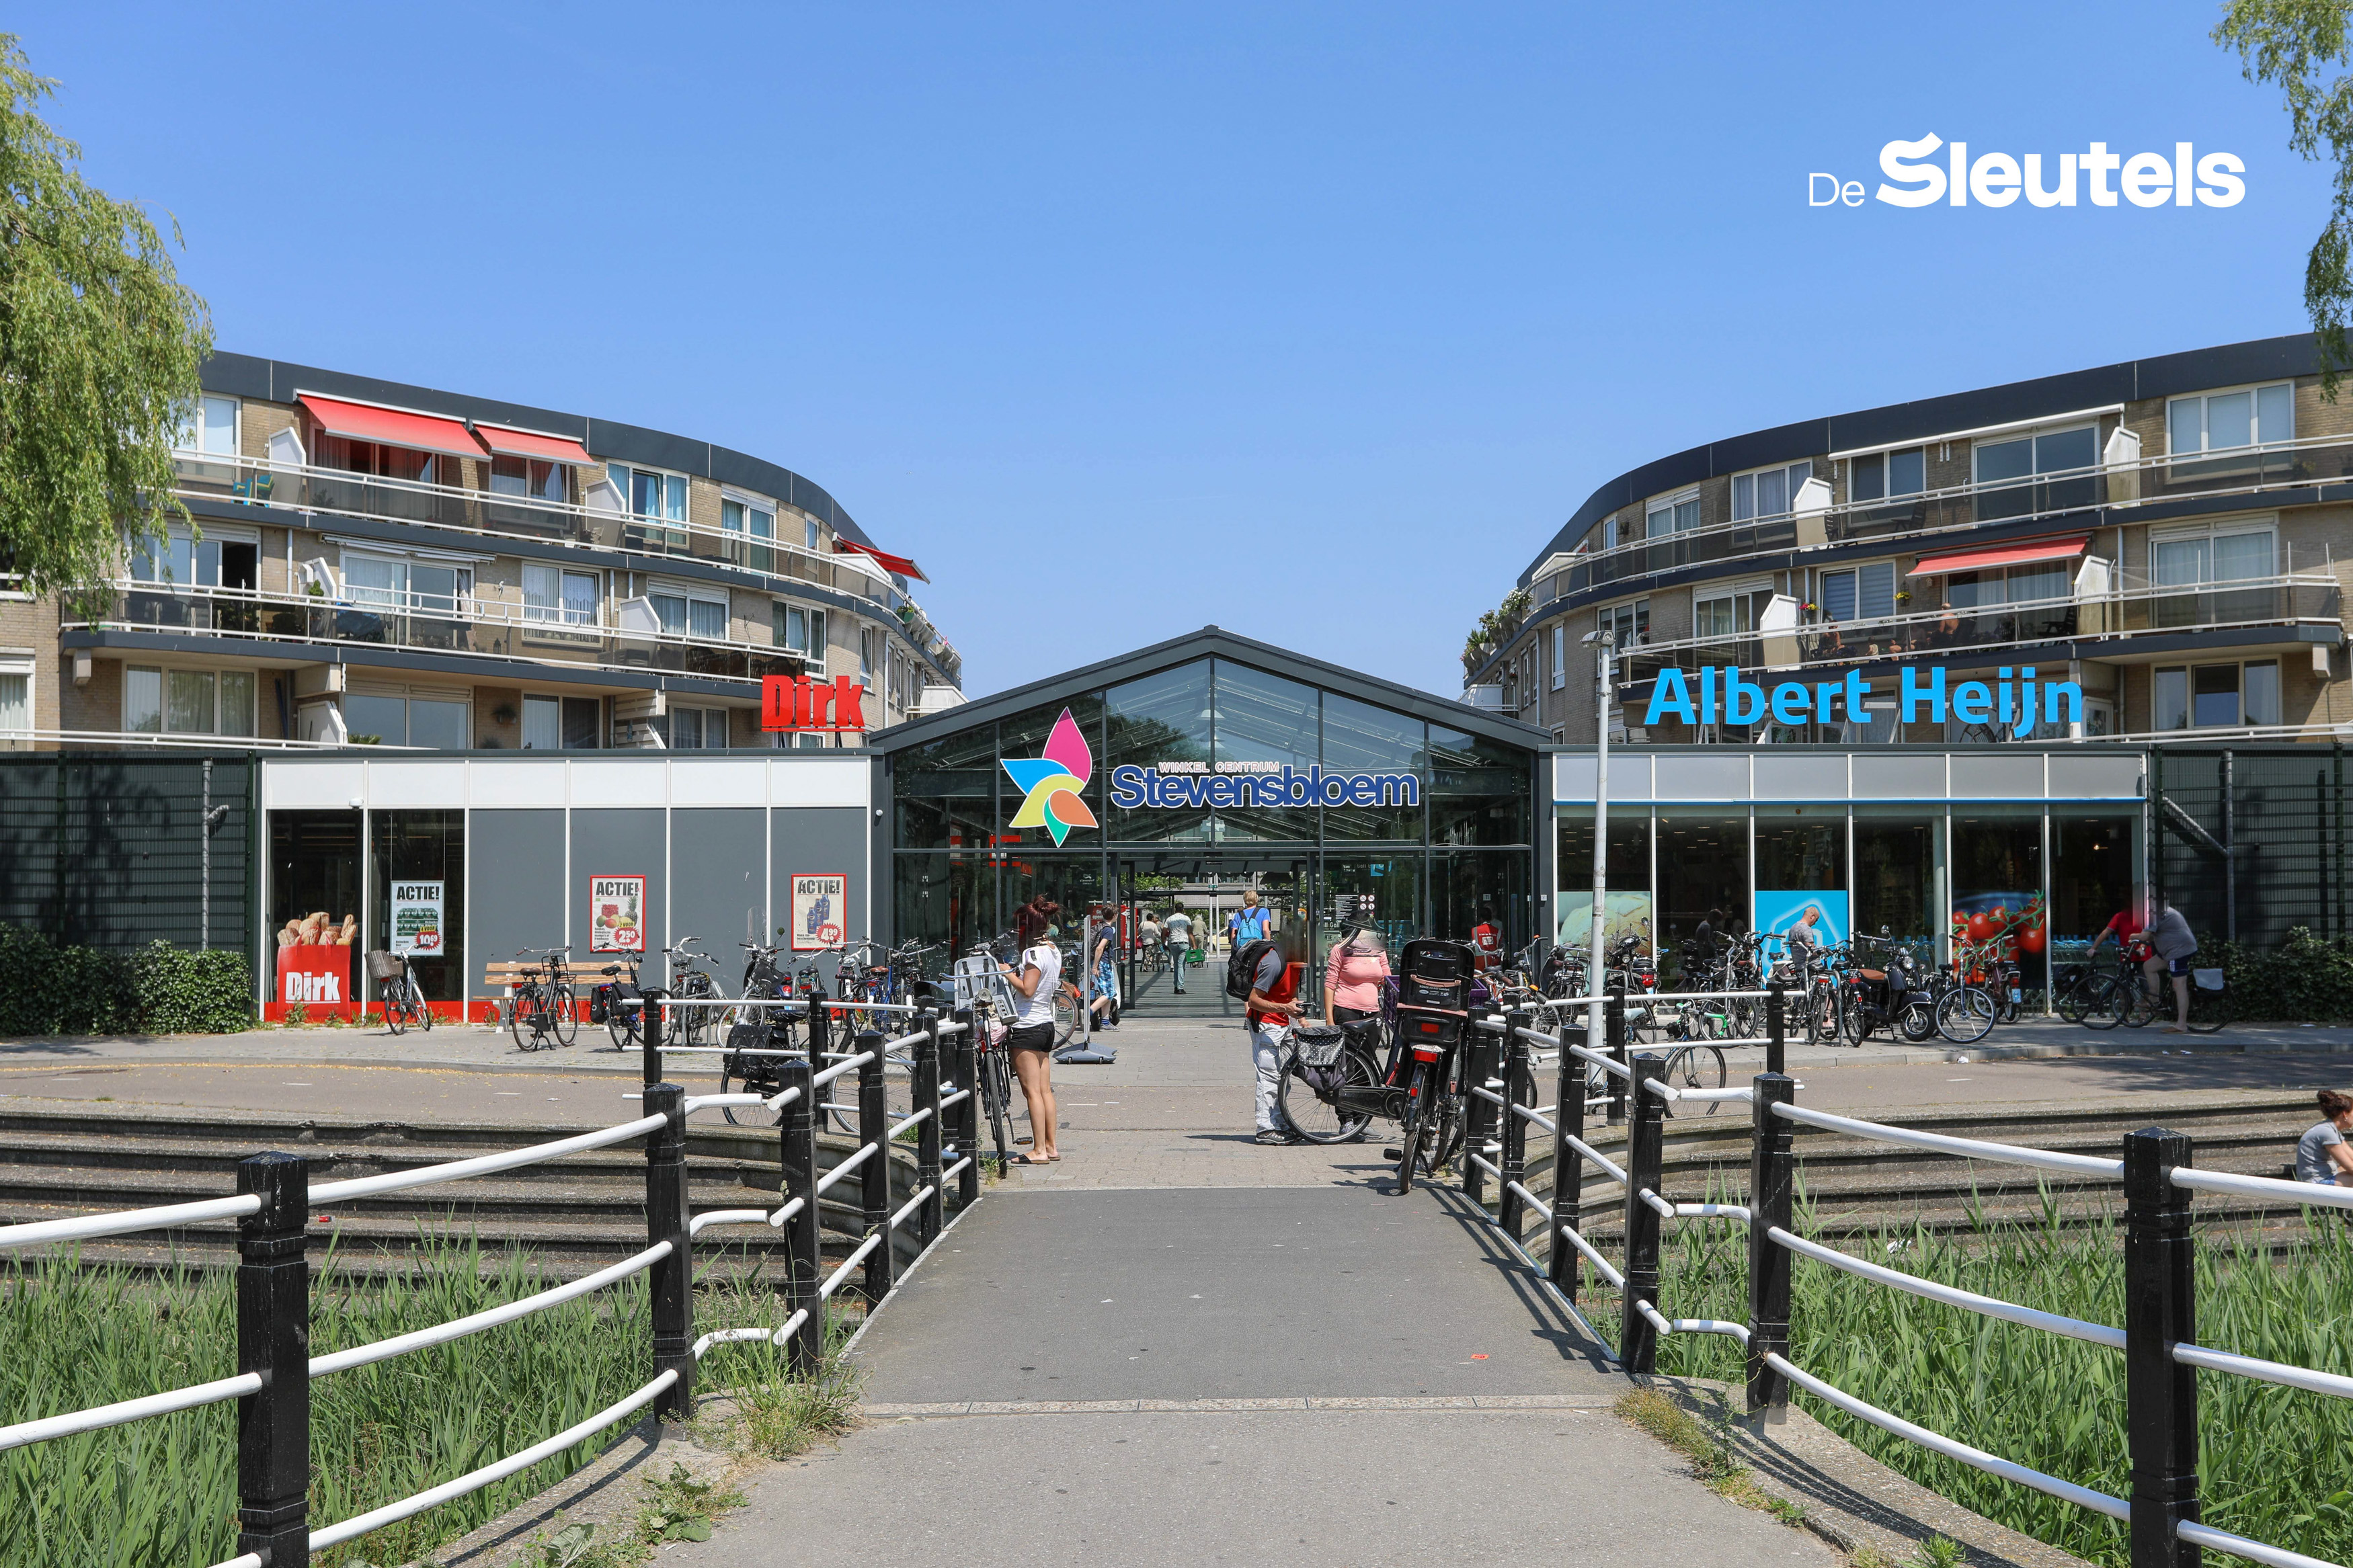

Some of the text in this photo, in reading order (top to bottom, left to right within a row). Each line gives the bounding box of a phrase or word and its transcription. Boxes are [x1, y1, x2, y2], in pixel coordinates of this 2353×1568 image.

[762, 675, 865, 727] Dirk
[1644, 665, 2082, 738] Albert Heijn
[1158, 761, 1279, 773] WINKEL CENTRUM
[1111, 764, 1419, 808] Stevensbloem
[397, 886, 440, 900] ACTIE!
[596, 882, 639, 896] ACTIE!
[797, 880, 840, 894] ACTIE!
[285, 972, 341, 1001] Dirk
